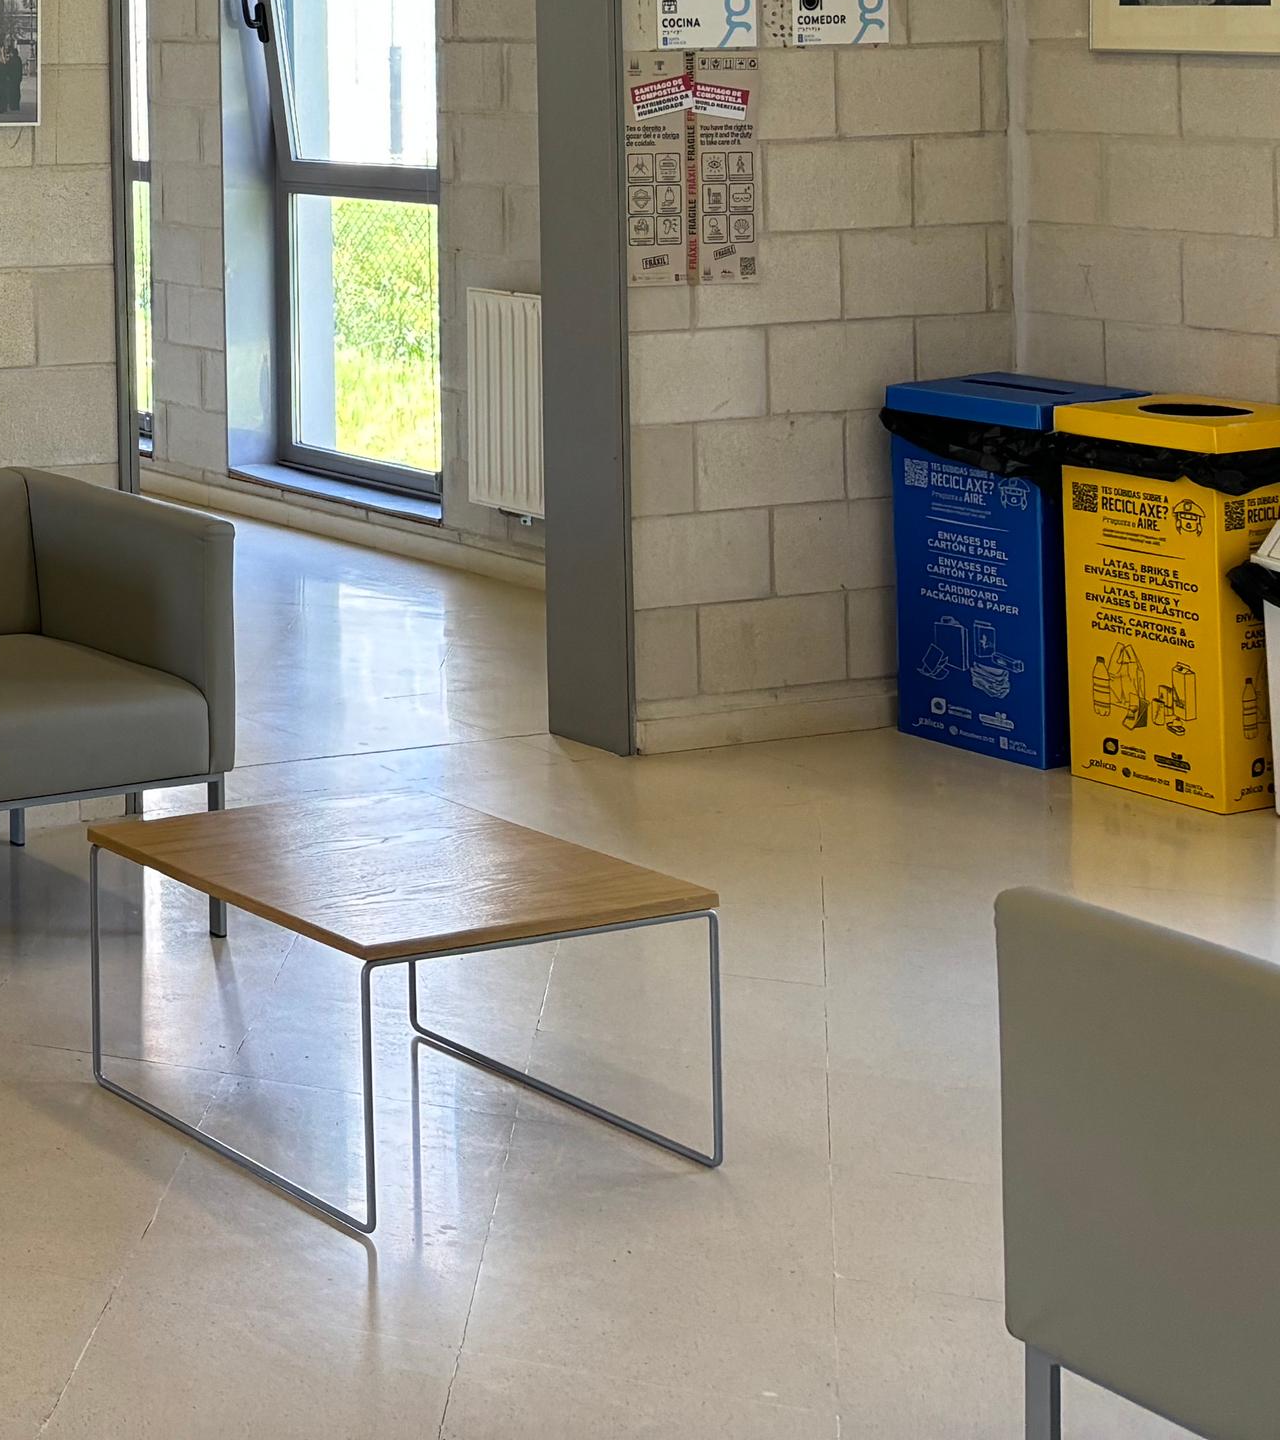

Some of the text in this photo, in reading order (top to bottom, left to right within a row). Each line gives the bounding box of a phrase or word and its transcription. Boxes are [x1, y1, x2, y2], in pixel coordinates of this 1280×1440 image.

[662, 18, 701, 28] COCINA
[797, 15, 846, 25] COMEDOR
[634, 78, 683, 96] SANTIAGO DE
[635, 85, 686, 102] COMPOSTELA
[696, 85, 731, 96] SANTIAGO
[696, 91, 743, 104] COMPOSTELA
[637, 101, 684, 117] HUMANIDADE
[733, 124, 746, 132] right
[687, 125, 696, 161] FRAGILE
[688, 199, 697, 236] FRAGILE
[688, 239, 697, 270] FRÁXIL
[931, 472, 995, 495] RECICLAXE?
[963, 492, 987, 506] AIRE.
[1101, 486, 1112, 495] TES
[1142, 492, 1162, 503] SOBRE
[1163, 495, 1169, 504] A
[1101, 496, 1169, 520] RECICLAXE?
[1248, 505, 1280, 524] RECICL
[1137, 517, 1160, 532] AIRE.
[938, 530, 997, 549] ENVASES DE
[927, 538, 1008, 561] CARTÓN E PAPEL
[926, 563, 1008, 587] CARTÓN Y PAPEL
[938, 556, 997, 575] ENVASES DE
[1103, 558, 1179, 579] LATAS, BRIKS E
[1084, 564, 1199, 592] ENVASES DE PLÁSTICO
[920, 588, 1019, 615] PACKAGING & PAPER
[938, 583, 999, 602] CARDBOARD
[1103, 585, 1180, 607] LATAS, BRIKS Y
[1085, 592, 1200, 621] ENVASES DE PLÁSTICO
[1096, 612, 1186, 637] CANS, CARTONS &
[1091, 621, 1195, 649] PLASTIC PACKAGING
